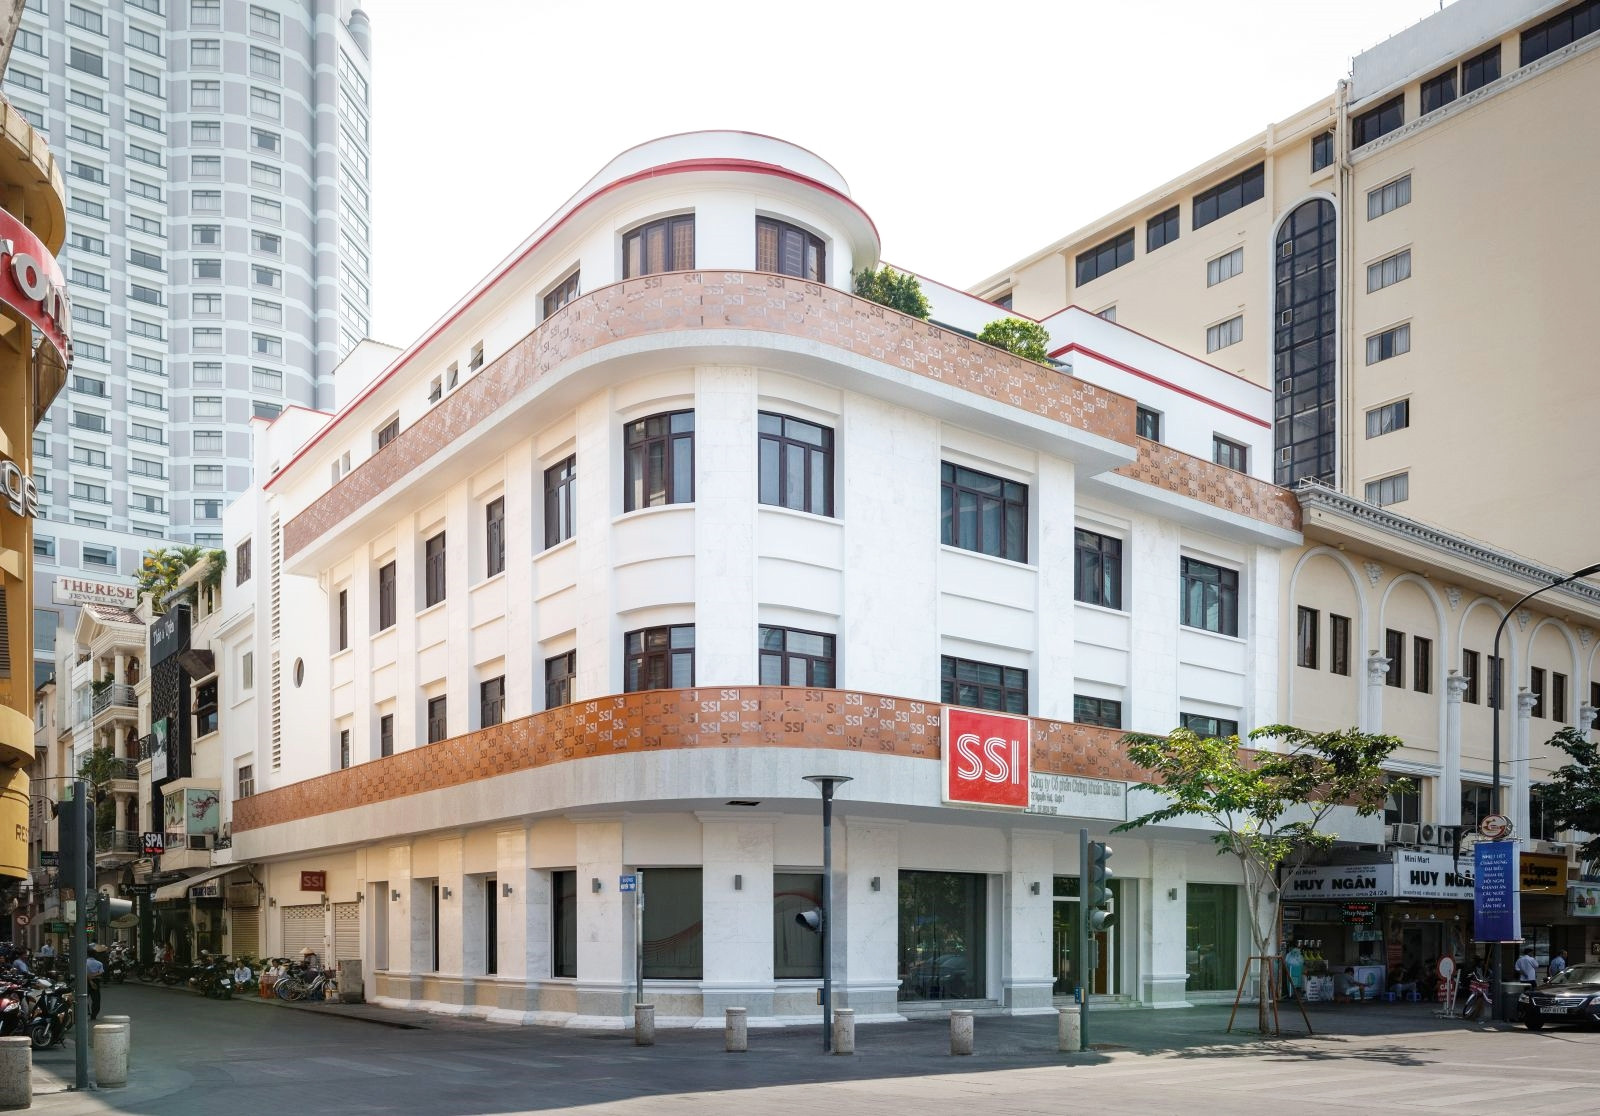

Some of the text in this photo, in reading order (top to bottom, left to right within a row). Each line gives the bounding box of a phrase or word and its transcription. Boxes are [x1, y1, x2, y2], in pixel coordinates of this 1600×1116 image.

[644, 277, 662, 289] SSI
[724, 273, 744, 284] SSI
[767, 277, 785, 289] SSI
[805, 283, 822, 297] SSI
[724, 295, 744, 305] SSI
[768, 298, 785, 309] SSI
[870, 306, 884, 319] SSI
[900, 316, 914, 329] SSI
[928, 327, 941, 340] SSI
[928, 346, 941, 359] SSI
[901, 355, 914, 369] SSI
[928, 365, 941, 378] SSI
[1009, 375, 1021, 387] SSI
[1073, 389, 1083, 400] SSI
[1083, 384, 1095, 396] SSI
[1009, 393, 1021, 406] SSI
[1096, 397, 1108, 409] SSI
[1083, 402, 1095, 414] SSI
[1060, 411, 1071, 423] SSI
[1151, 443, 1159, 453] SSI
[1150, 460, 1160, 469] SSI
[1150, 475, 1159, 485] SSI
[1180, 477, 1189, 486] SSI
[1189, 472, 1197, 481] SSI
[1170, 482, 1178, 491] SSI
[1189, 487, 1198, 497] SSI
[1207, 494, 1216, 503] SSI
[1215, 489, 1224, 498] SSI
[1234, 495, 1242, 504] SSI
[61, 579, 135, 599] THERESE
[69, 592, 127, 605] JEWELRY
[720, 690, 739, 701] SSI
[805, 691, 824, 702] SSI
[845, 694, 863, 705] SSI
[585, 702, 598, 714] SSI
[613, 698, 627, 709] SSI
[701, 701, 720, 712] SSI
[741, 700, 761, 711] SSI
[880, 698, 895, 710] SSI
[910, 703, 925, 714] SSI
[547, 712, 555, 723] SSI
[598, 710, 612, 721] SSI
[720, 711, 739, 722] SSI
[863, 706, 879, 718] SSI
[895, 711, 909, 722] SSI
[575, 715, 585, 726] SSI
[613, 719, 627, 730] SSI
[845, 715, 863, 726] SSI
[880, 719, 895, 730] SSI
[926, 715, 939, 727] SSI
[586, 723, 598, 734] SSI
[701, 722, 720, 733] SSI
[741, 721, 762, 732] SSI
[784, 722, 804, 732] SSI
[910, 723, 924, 735] SSI
[1049, 723, 1061, 732] SSI
[564, 728, 574, 738] SSI
[598, 730, 613, 741] SSI
[575, 734, 585, 745] SSI
[644, 736, 661, 747] SSI
[880, 740, 895, 751] SSI
[564, 747, 574, 757] SSI
[957, 733, 1019, 785] SSI
[1044, 778, 1049, 792] ty
[145, 833, 163, 848] SPA
[1405, 854, 1430, 864] Mini Mart
[303, 876, 323, 887] SSI
[1294, 875, 1376, 890] HUY NGÂN
[1410, 870, 1475, 887] HUY NGÂ
